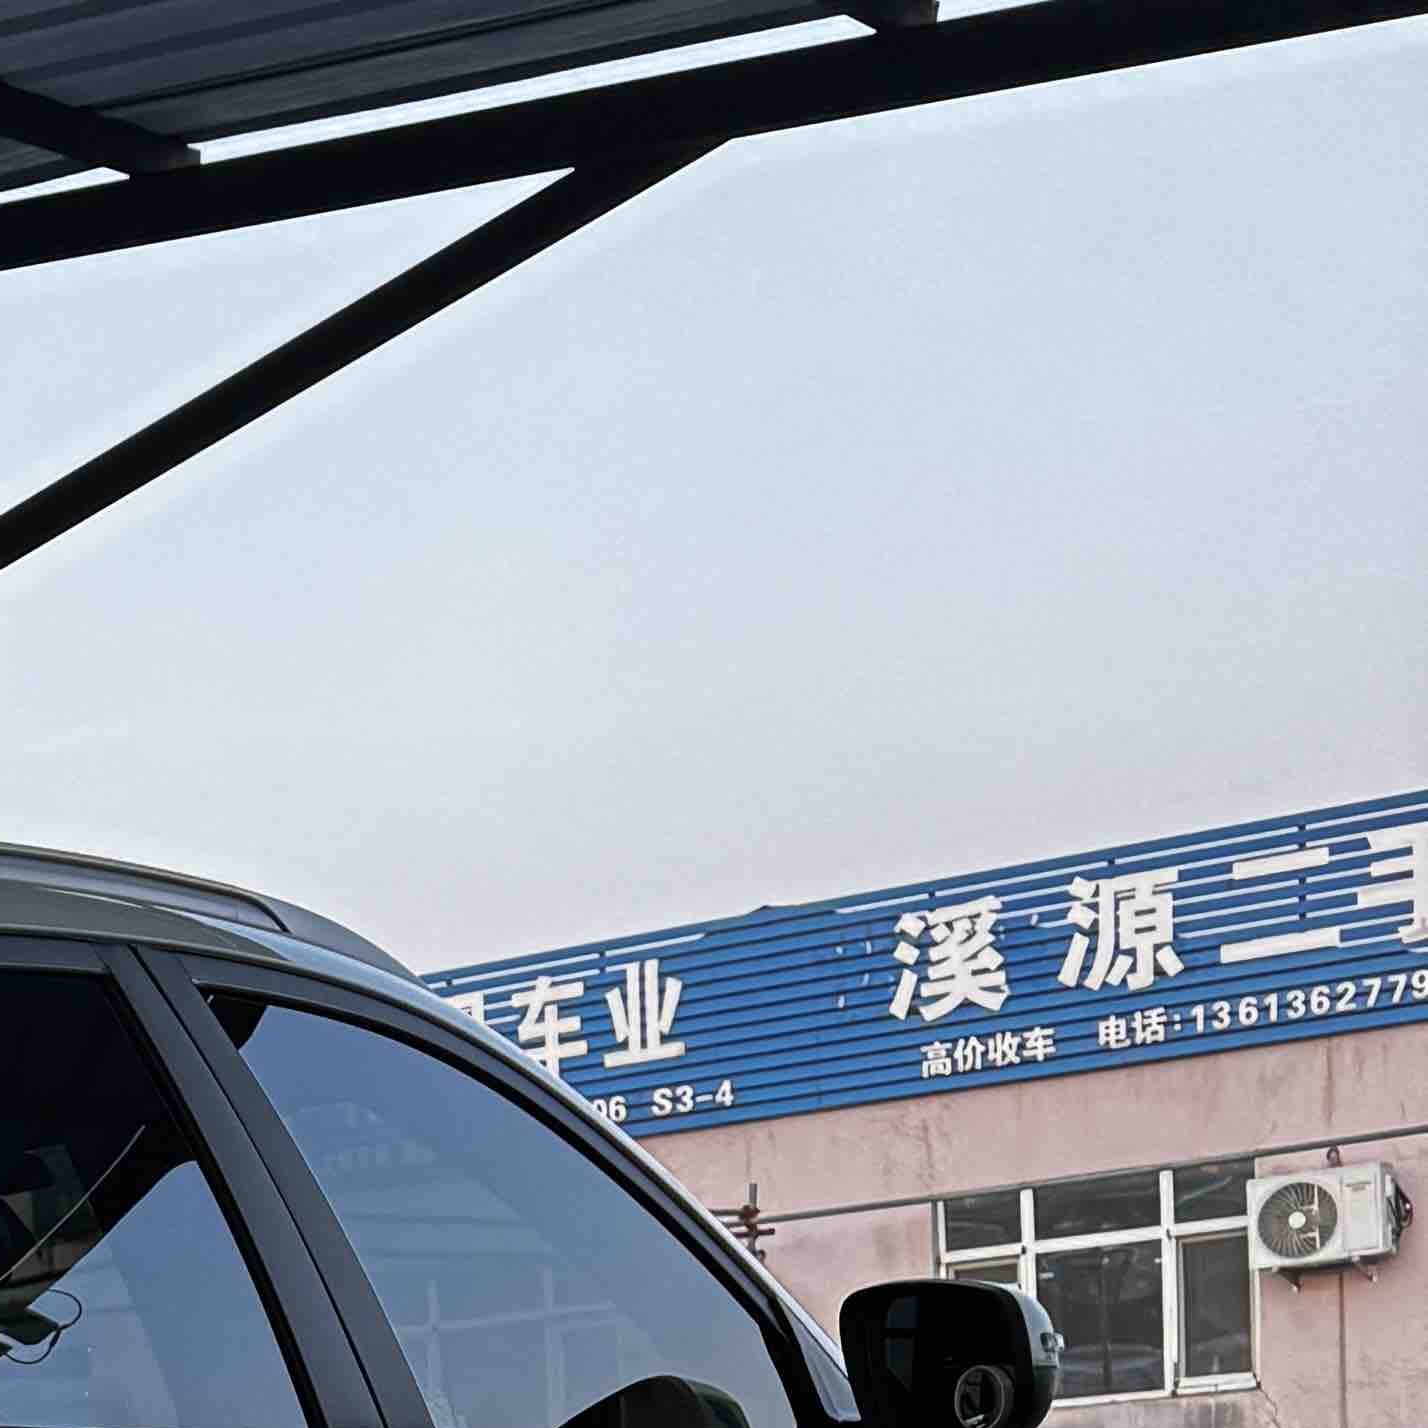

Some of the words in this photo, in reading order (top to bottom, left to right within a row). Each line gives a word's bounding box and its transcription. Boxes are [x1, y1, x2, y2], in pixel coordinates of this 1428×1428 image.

[446, 959, 687, 1079] 车业
[920, 1027, 1056, 1078] 高价收车
[651, 1080, 734, 1116] S3-4
